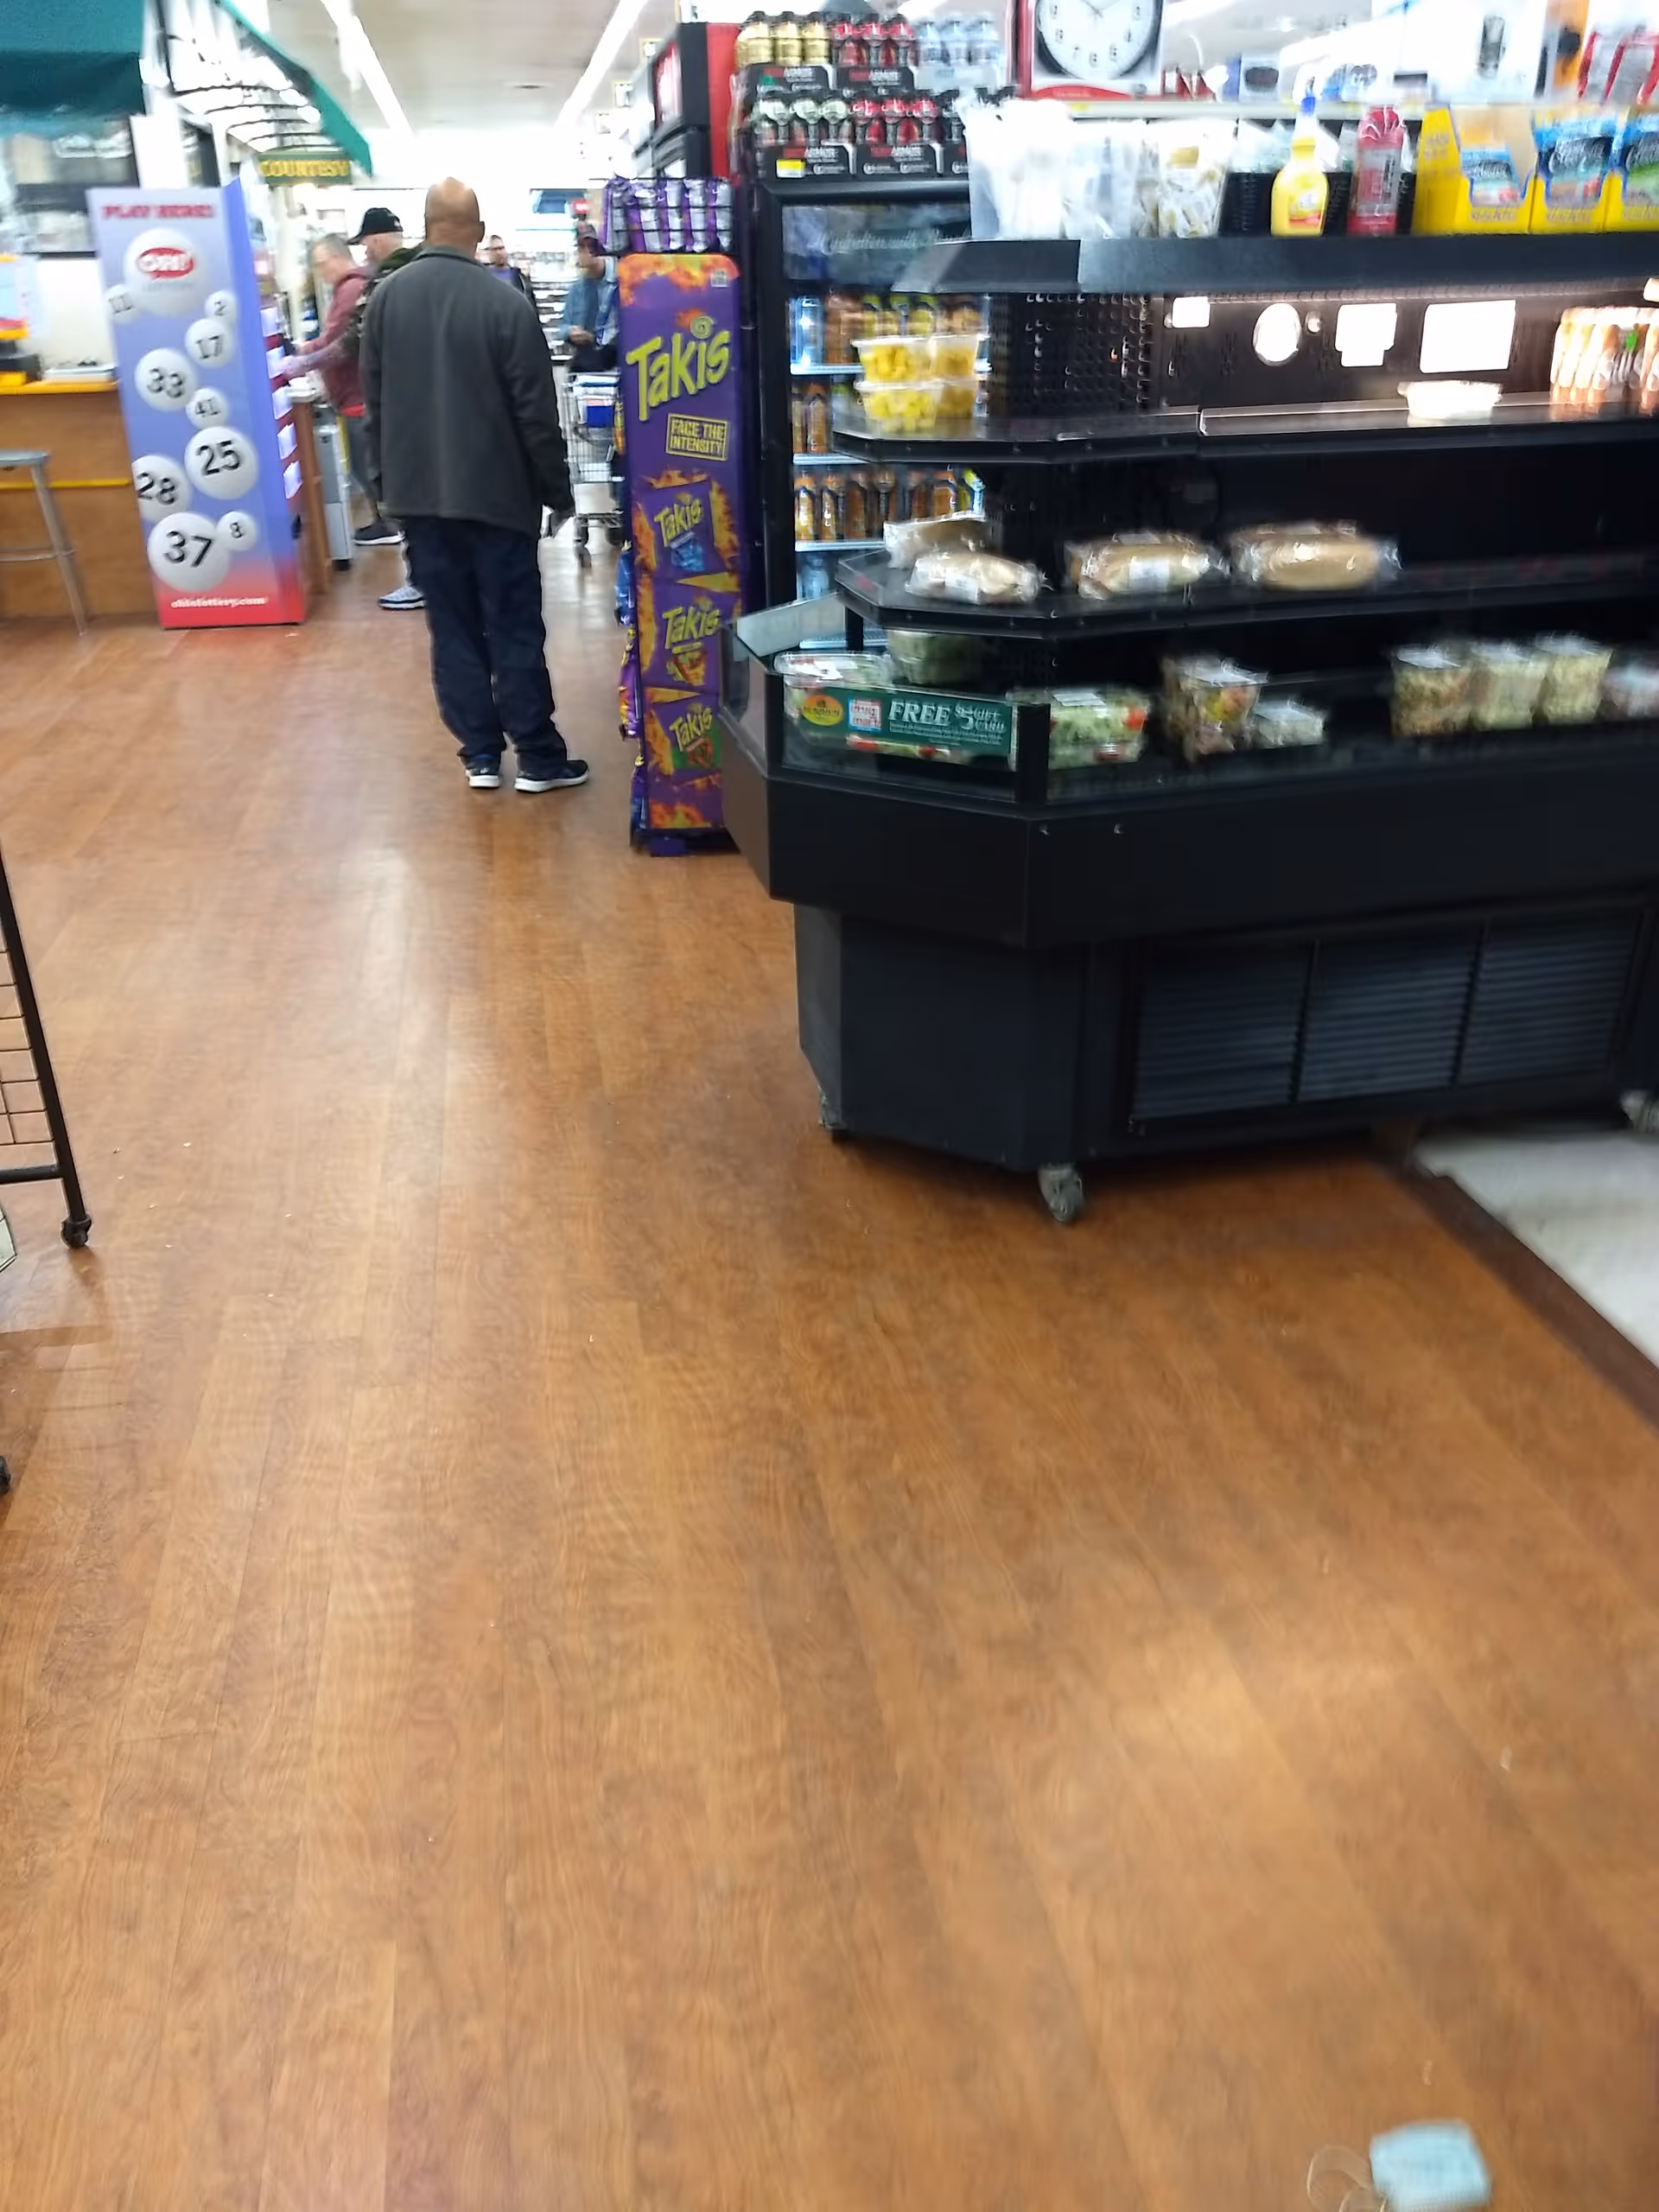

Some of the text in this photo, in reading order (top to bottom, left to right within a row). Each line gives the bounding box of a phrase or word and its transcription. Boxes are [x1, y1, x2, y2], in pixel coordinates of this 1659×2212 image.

[260, 159, 350, 177] COURTESY
[102, 204, 150, 219] PLAY
[196, 334, 224, 360] 17
[147, 368, 185, 398] 33
[626, 315, 731, 422] Takis
[671, 418, 726, 440] FACE THE
[197, 440, 242, 475] 25
[671, 435, 724, 455] INTENSITY
[136, 472, 177, 505] 28
[229, 522, 245, 539] 8
[654, 495, 703, 547] Takis
[163, 531, 214, 568] 37
[662, 601, 720, 650] Takis
[670, 704, 713, 752] Takis
[888, 700, 951, 727] FREE
